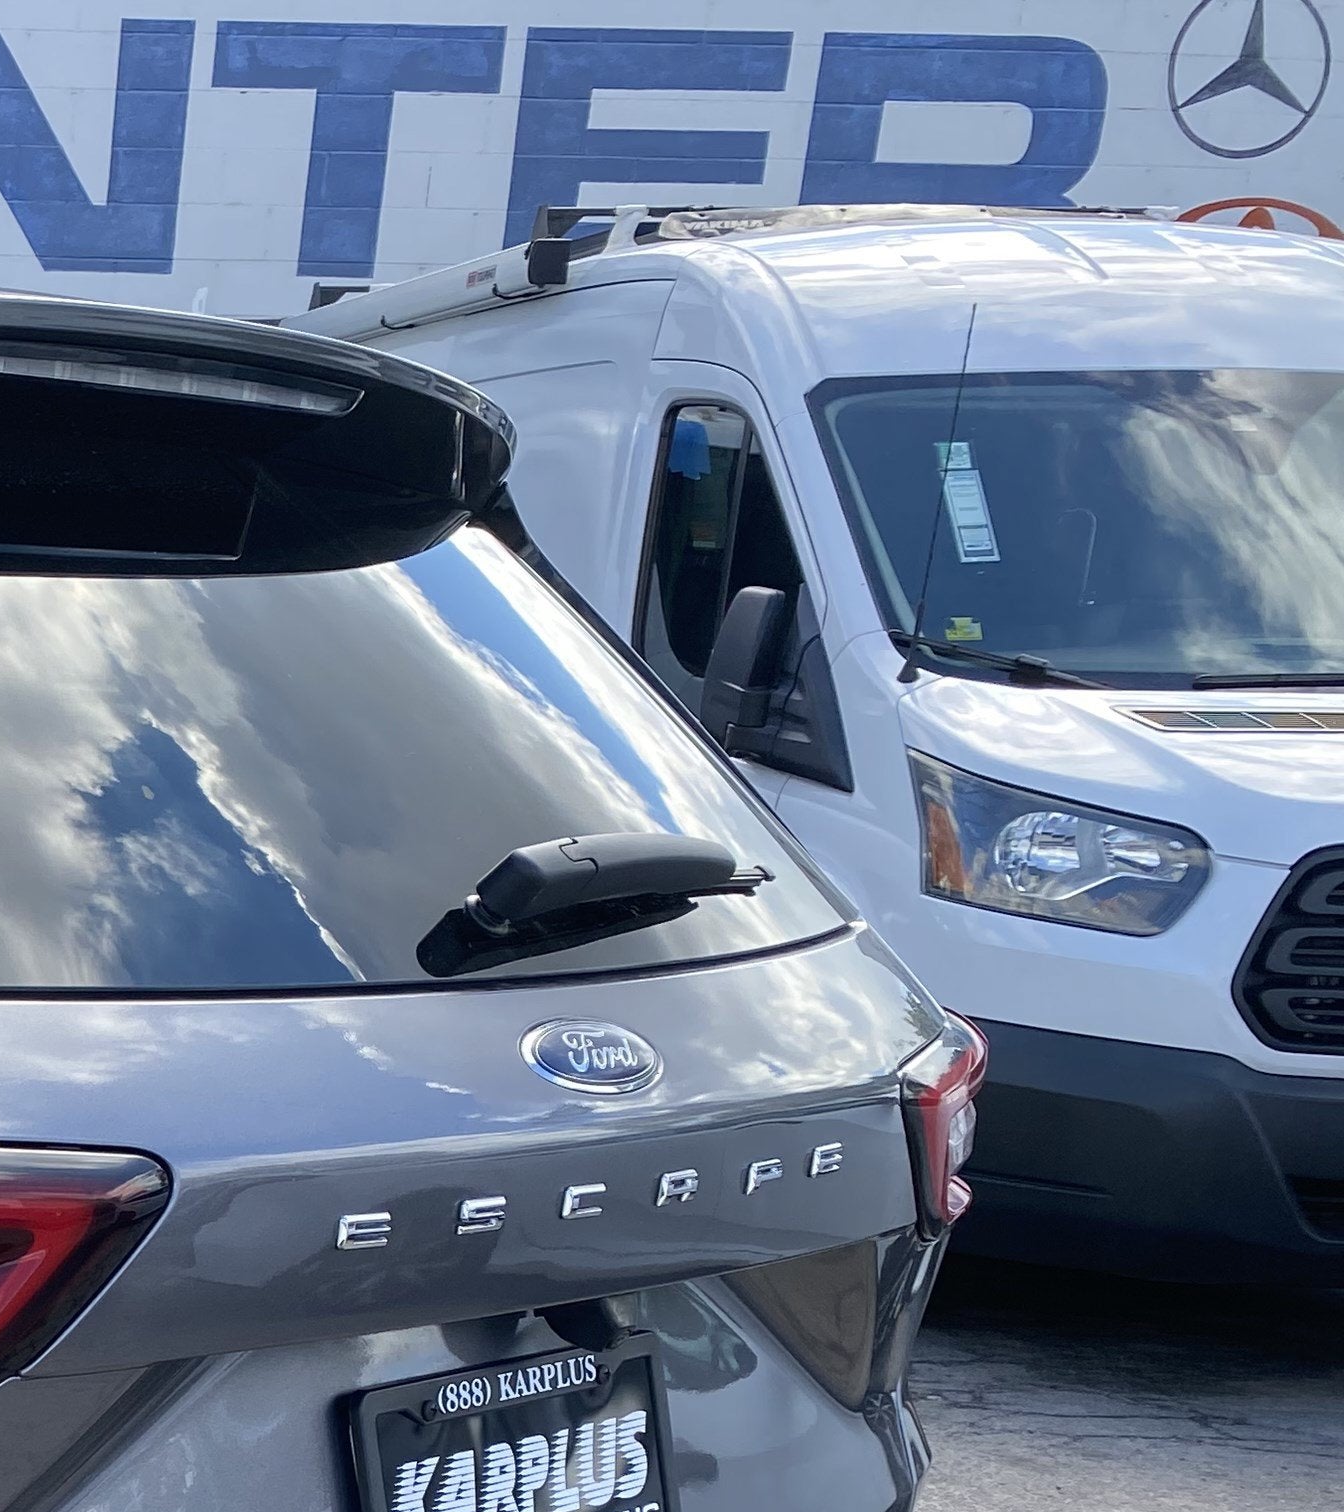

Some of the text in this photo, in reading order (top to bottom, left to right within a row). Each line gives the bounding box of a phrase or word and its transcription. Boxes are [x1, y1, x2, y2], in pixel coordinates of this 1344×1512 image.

[561, 1029, 639, 1073] Ford
[336, 1141, 844, 1251] ESCAPE
[437, 1354, 598, 1415] (888) KARPLUS
